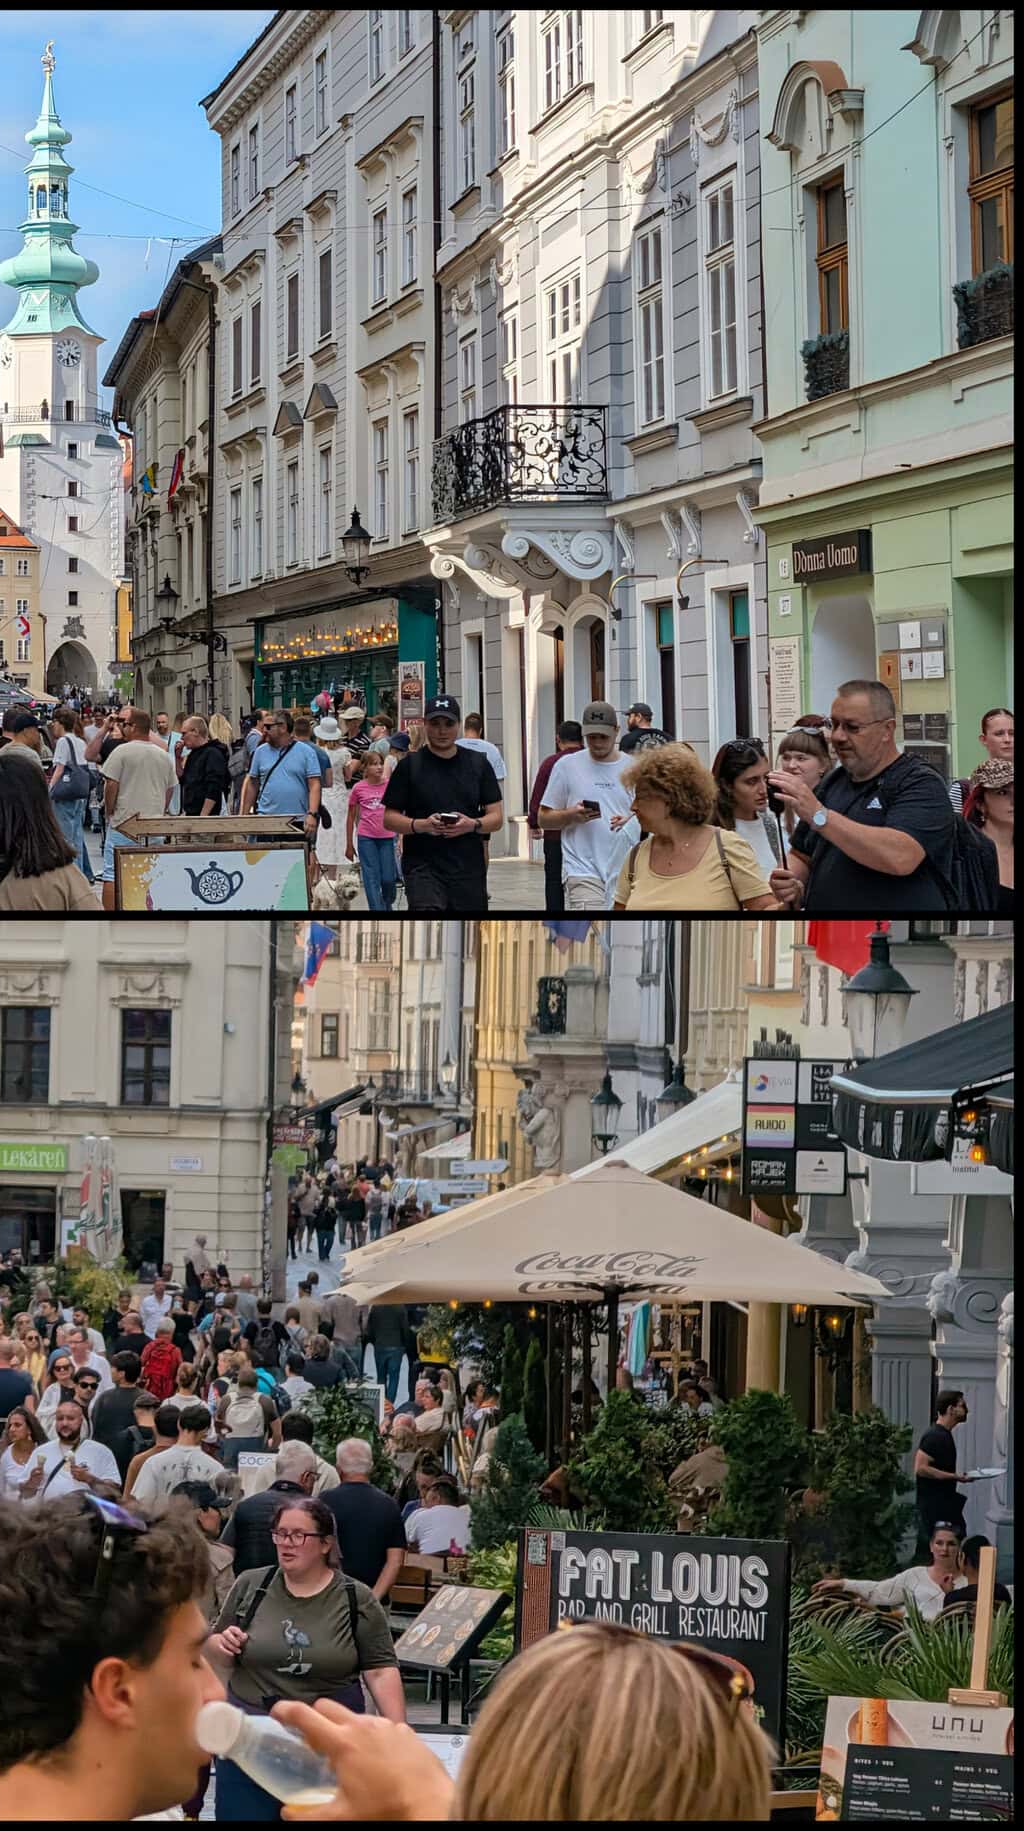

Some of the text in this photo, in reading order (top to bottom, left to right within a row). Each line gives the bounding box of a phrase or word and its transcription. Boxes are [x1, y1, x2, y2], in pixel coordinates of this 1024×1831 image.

[827, 543, 857, 568] Uomo
[2, 1147, 65, 1168] Lekáreň
[559, 1547, 640, 1600] FAT
[651, 1551, 769, 1608] LOUIS
[595, 1601, 623, 1625] AND
[631, 1603, 669, 1635] GRILL
[679, 1606, 768, 1641] RESTAURANT
